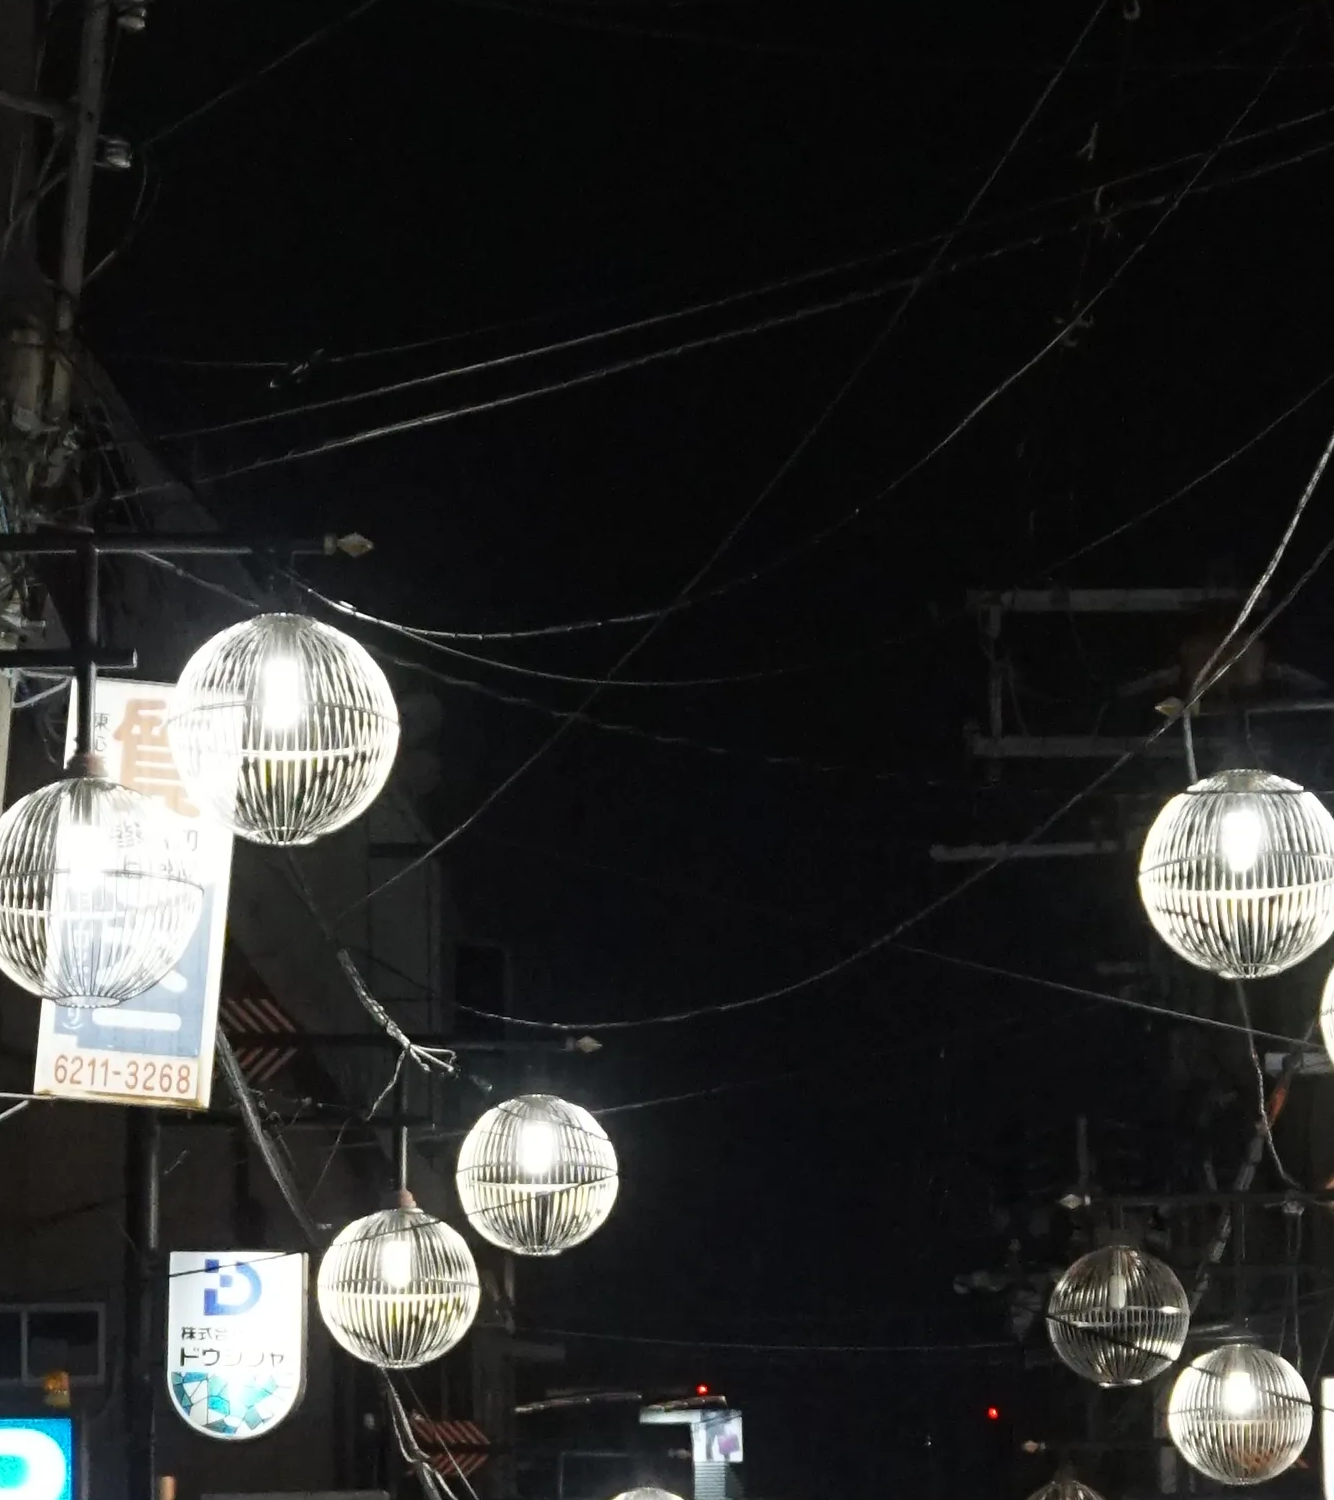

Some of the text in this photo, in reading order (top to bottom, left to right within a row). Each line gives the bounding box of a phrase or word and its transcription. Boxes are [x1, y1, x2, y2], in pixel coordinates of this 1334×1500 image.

[54, 1054, 192, 1095] 6211-3268
[180, 1326, 244, 1342] 株式会
